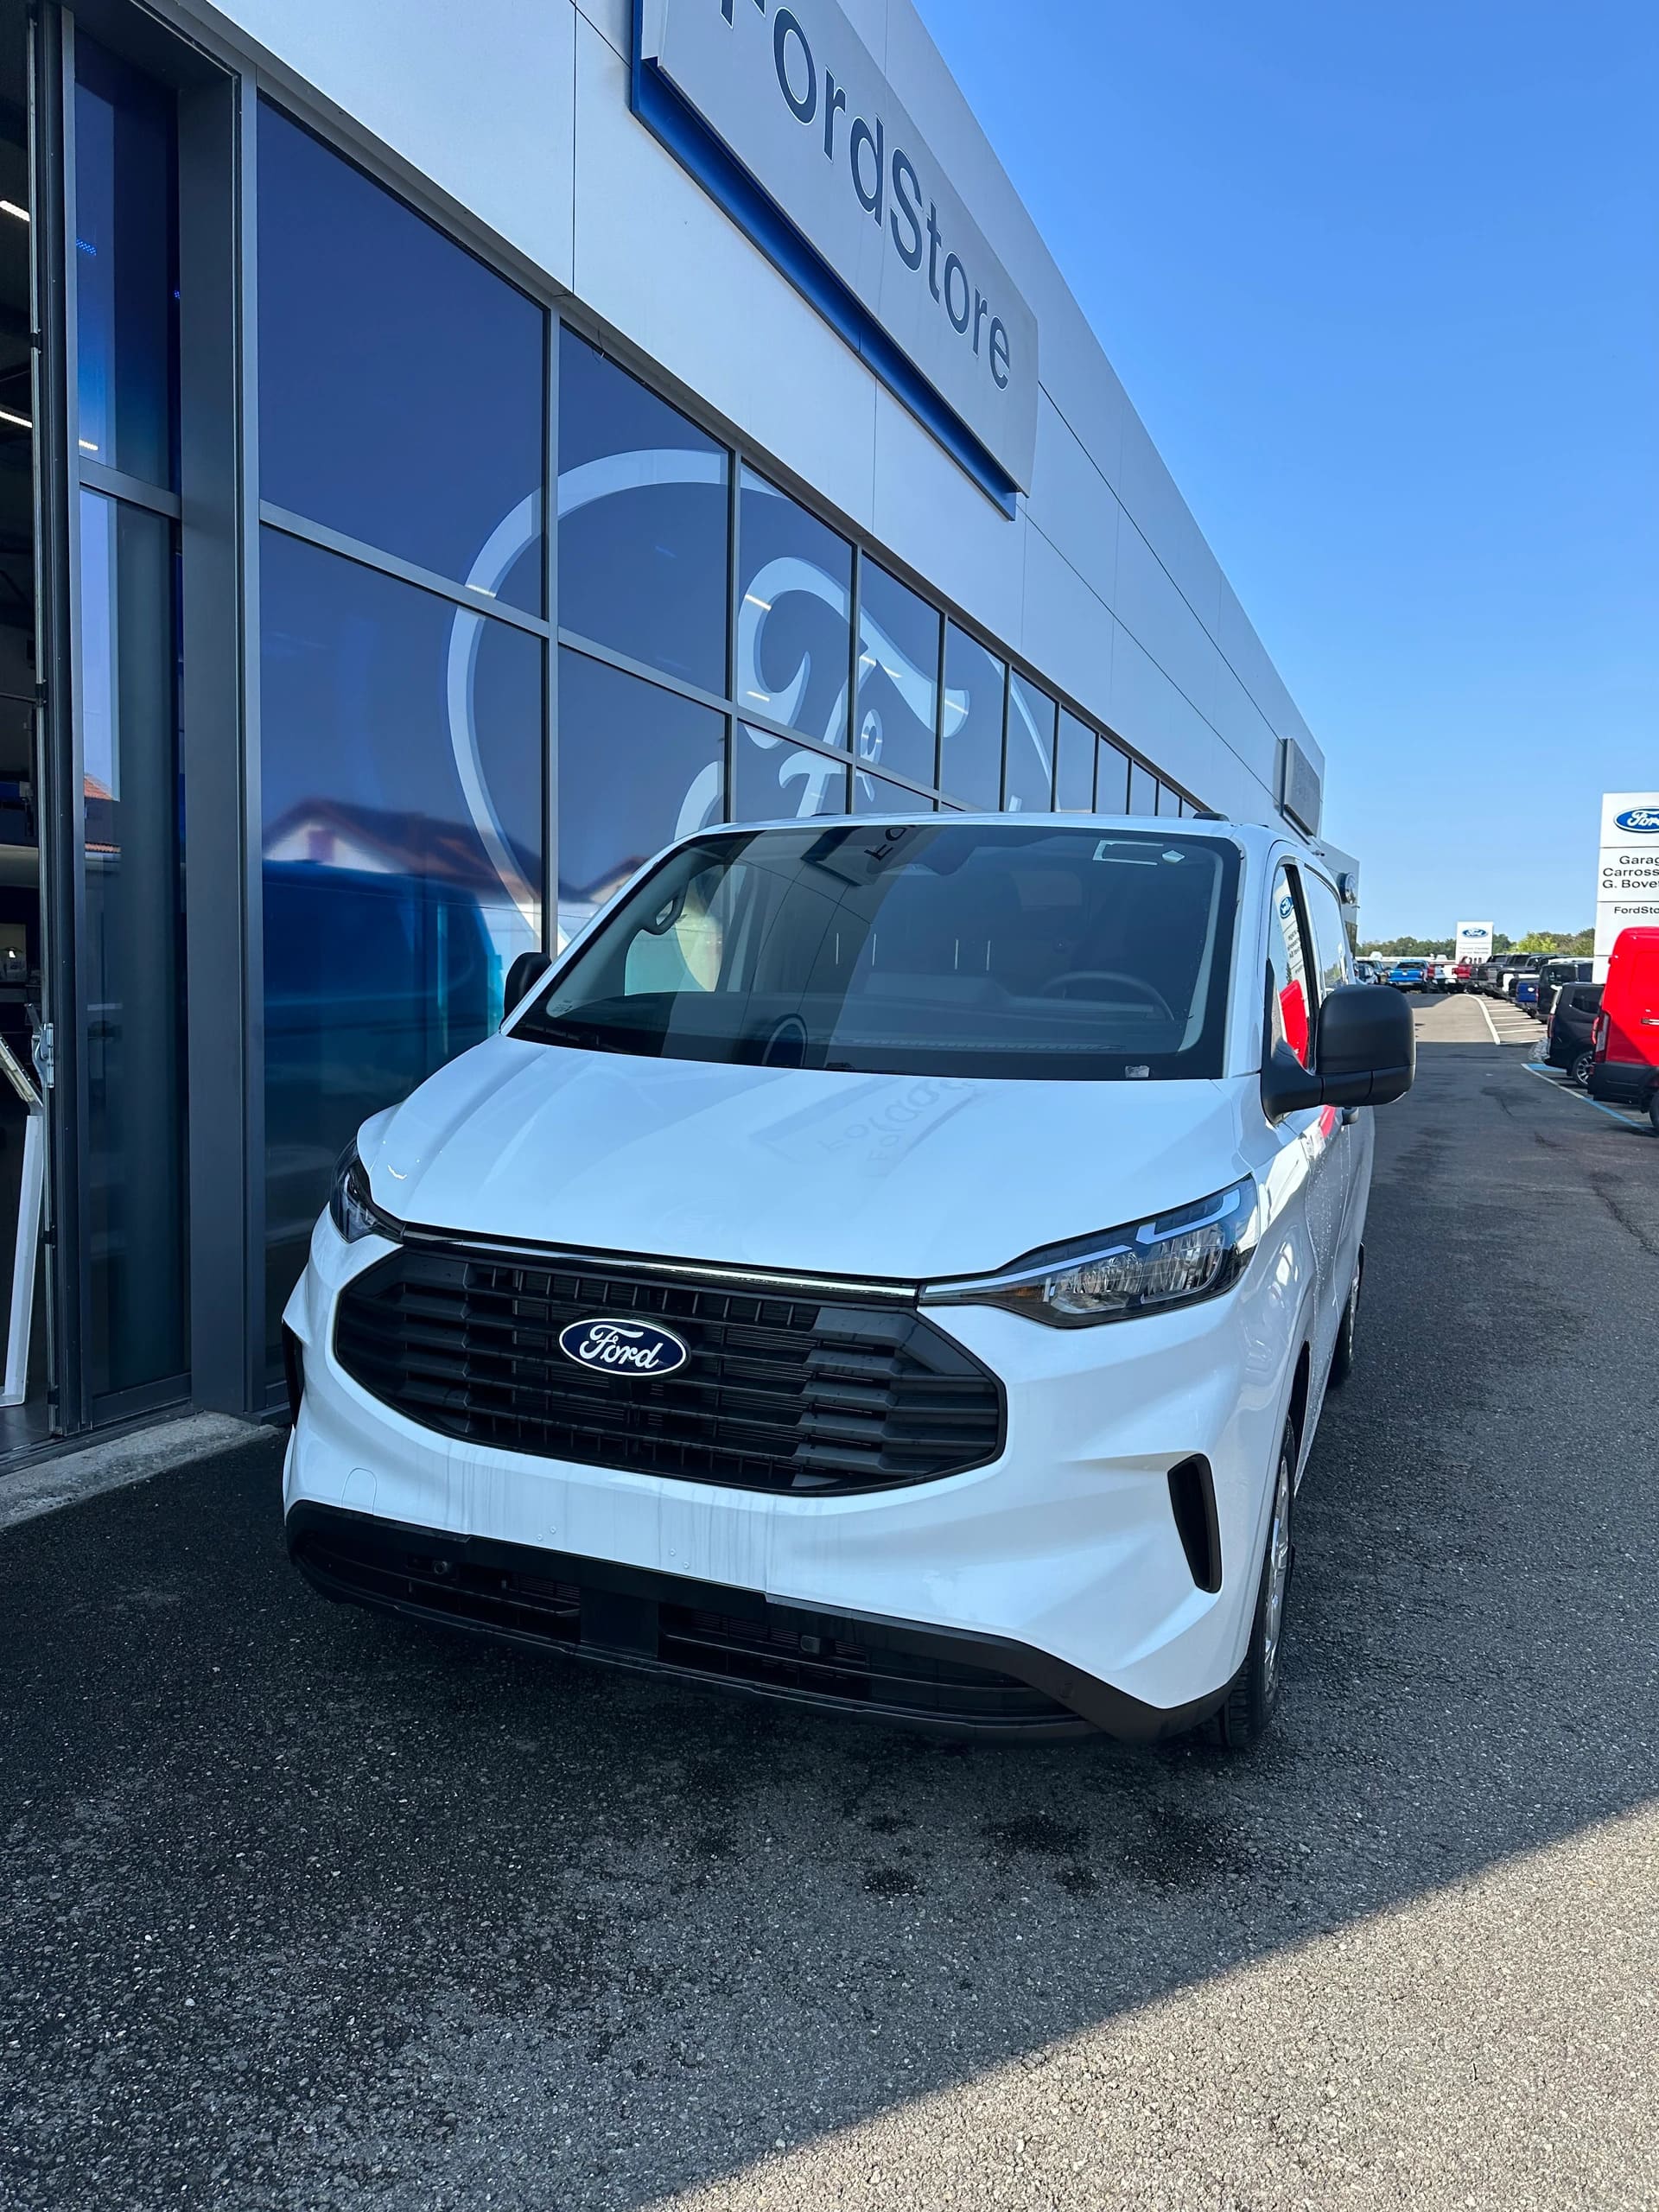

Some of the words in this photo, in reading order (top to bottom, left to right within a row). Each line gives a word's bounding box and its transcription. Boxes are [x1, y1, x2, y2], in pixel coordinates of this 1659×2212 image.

[1627, 810, 1659, 827] For
[1602, 880, 1618, 889] G.
[1621, 879, 1659, 888] Bove
[579, 1324, 664, 1369] Ford
